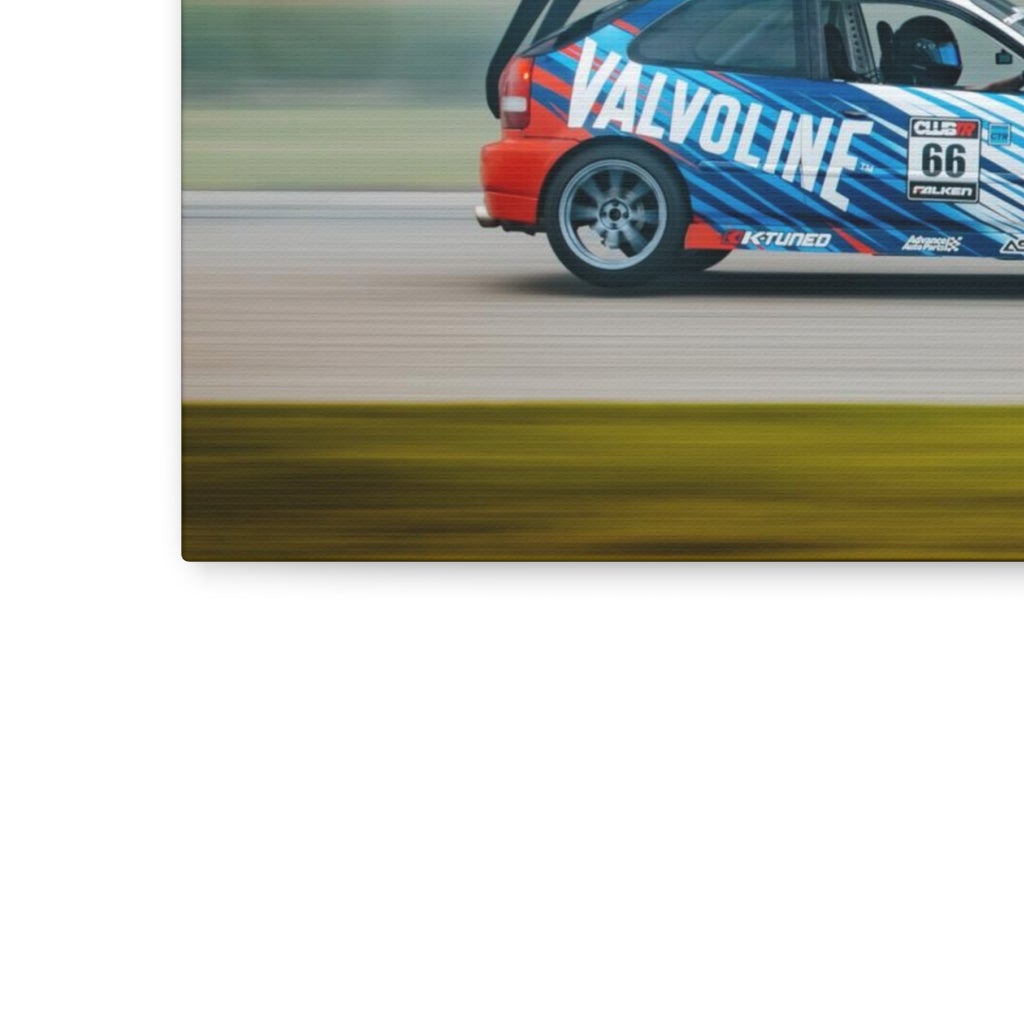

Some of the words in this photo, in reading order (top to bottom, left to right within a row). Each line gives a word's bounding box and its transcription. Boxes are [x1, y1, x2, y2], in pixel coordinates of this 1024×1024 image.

[567, 36, 873, 212] VALVOLINE
[922, 142, 967, 178] 66
[912, 185, 973, 197] FALKEN
